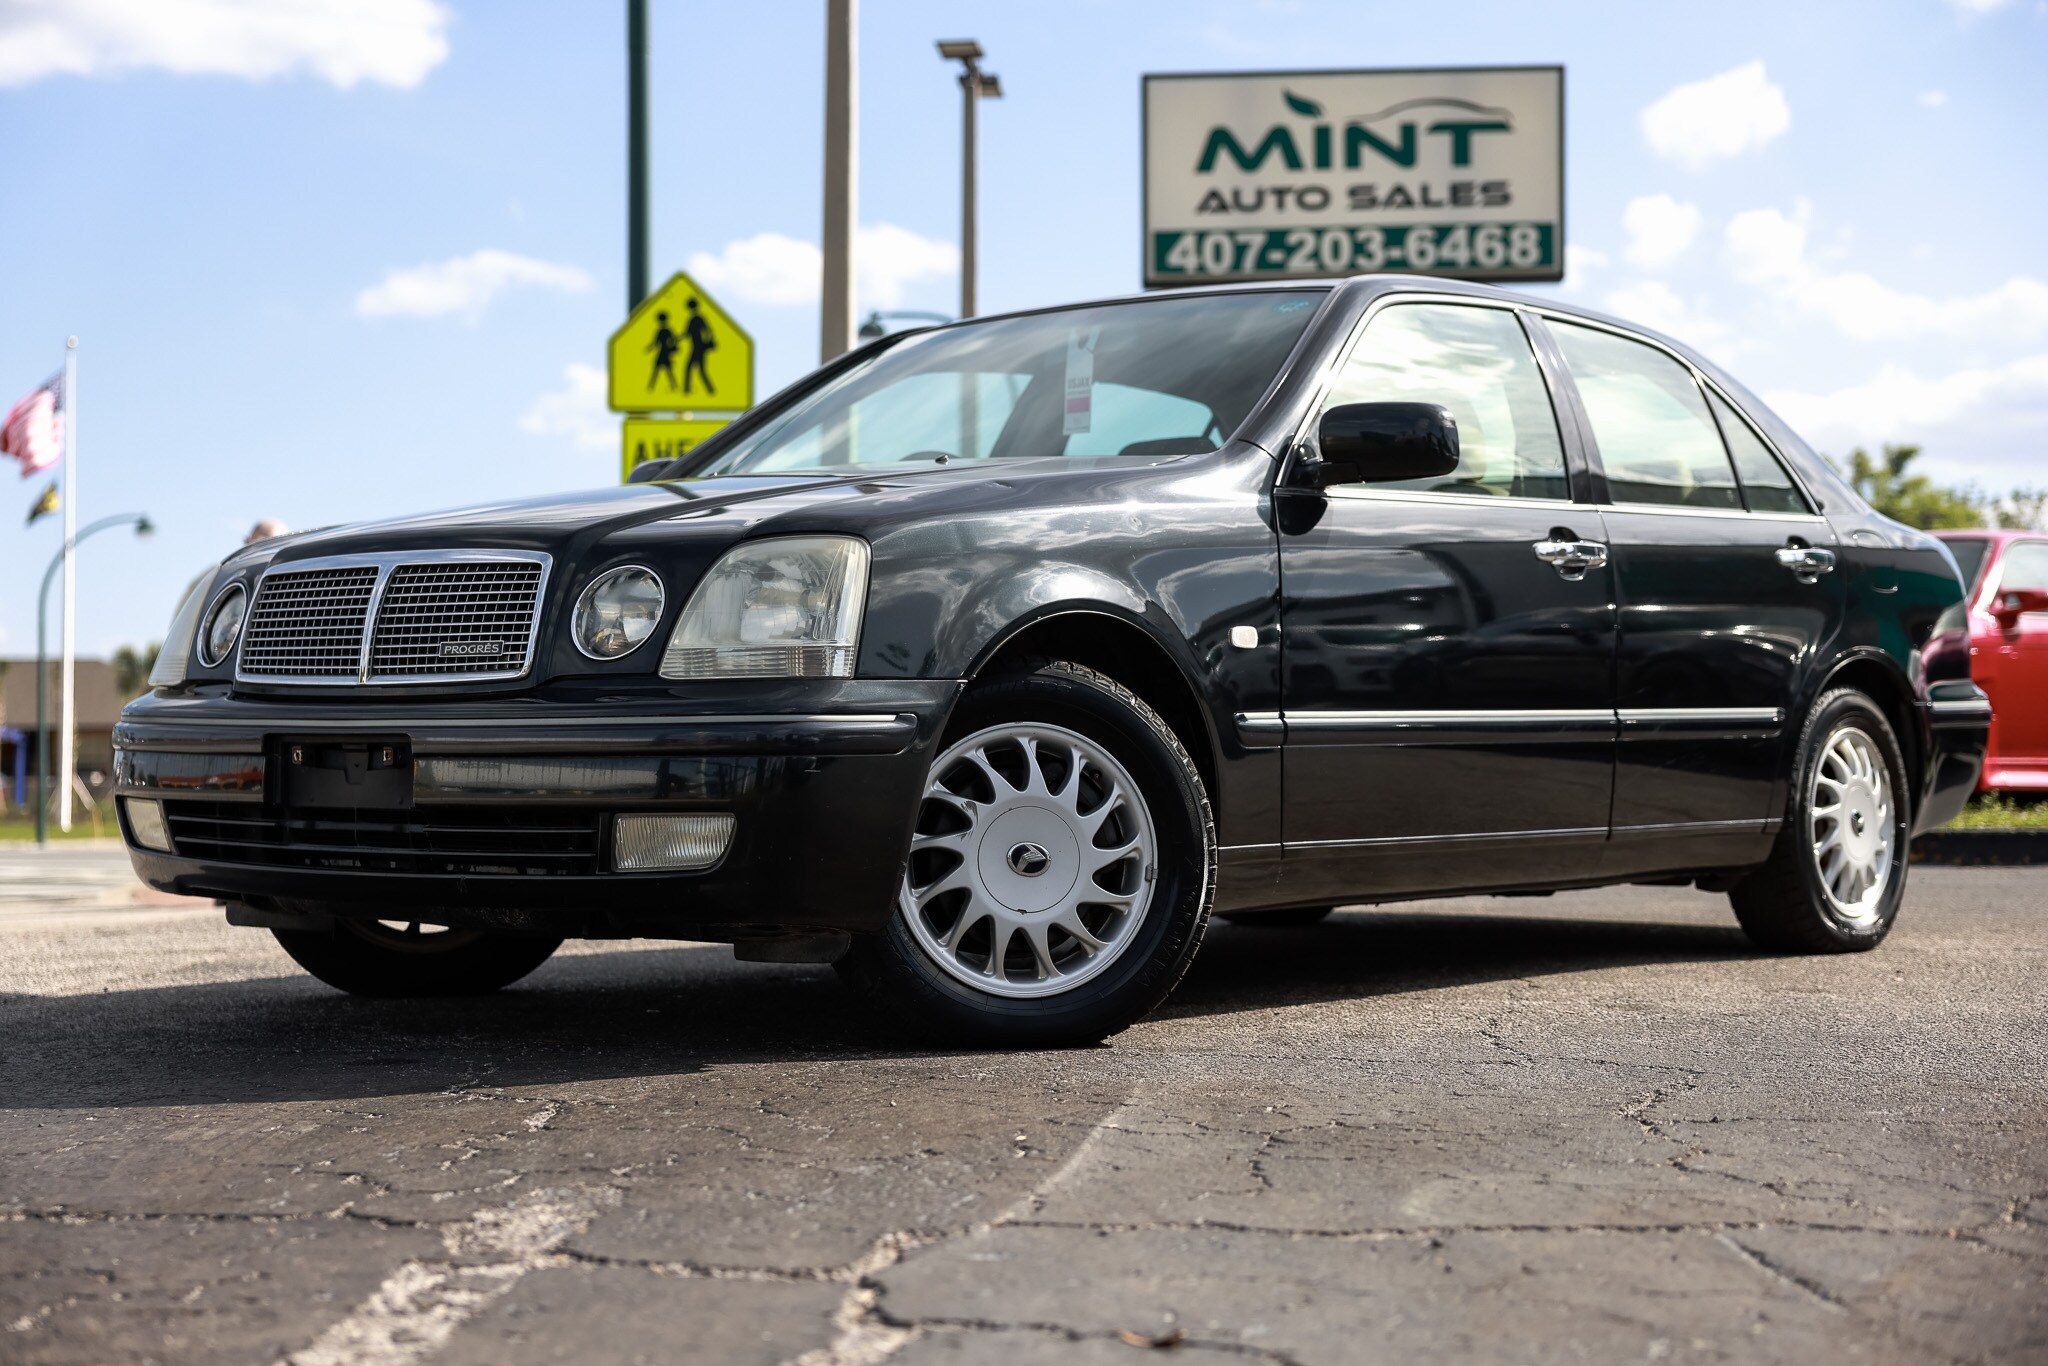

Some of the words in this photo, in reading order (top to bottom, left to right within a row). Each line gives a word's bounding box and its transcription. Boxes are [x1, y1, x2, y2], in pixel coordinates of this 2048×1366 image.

[1195, 120, 1514, 173] MINT
[1197, 184, 1332, 215] AUTO
[1346, 179, 1513, 212] SALES
[1165, 223, 1542, 275] 407-203-6468
